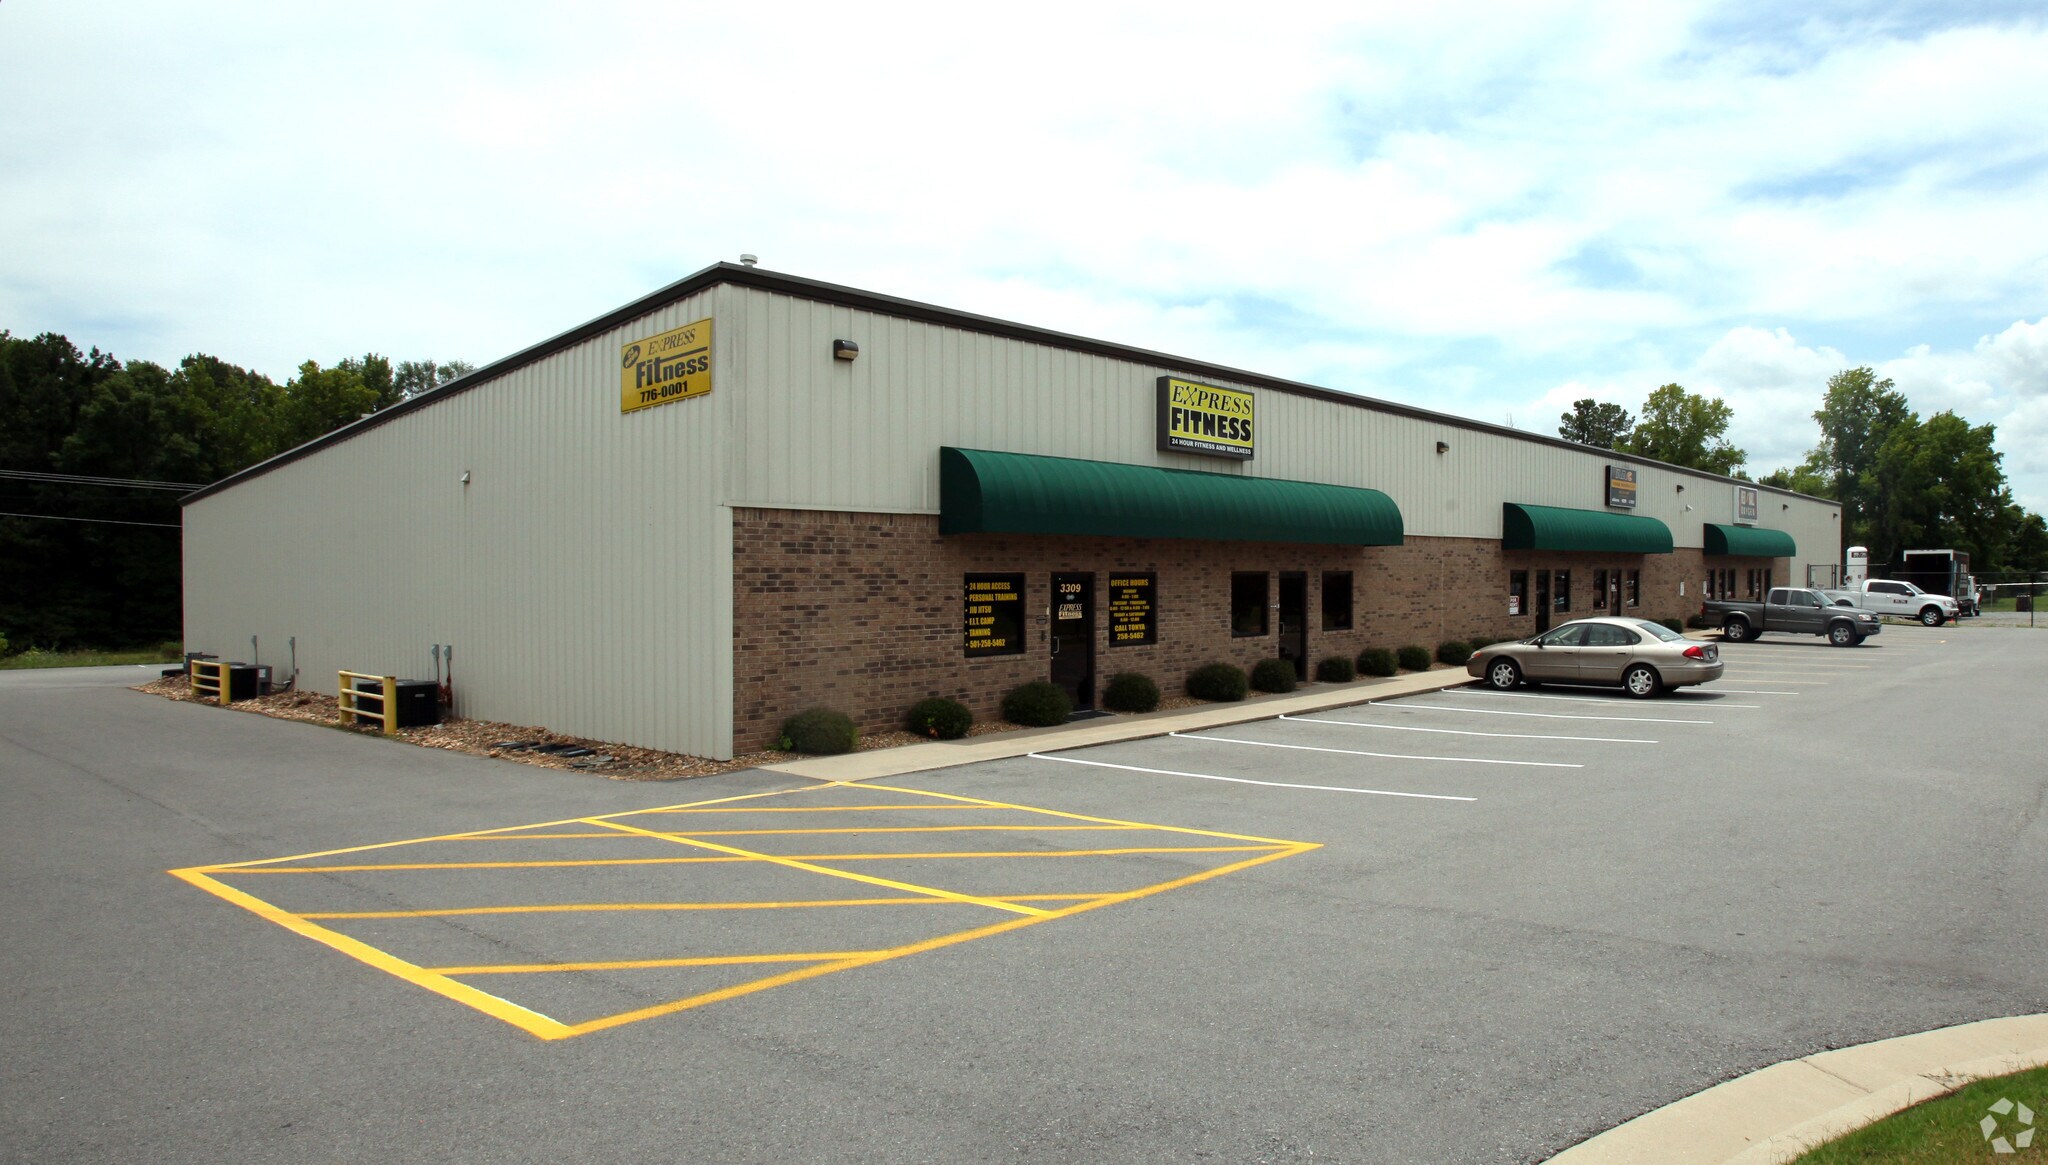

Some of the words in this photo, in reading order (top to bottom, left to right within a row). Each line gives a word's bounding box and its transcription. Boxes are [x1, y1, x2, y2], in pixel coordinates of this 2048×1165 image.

[648, 328, 696, 355] EXPRESS
[636, 355, 709, 389] Fitness
[640, 381, 688, 403] 776-0001
[1172, 385, 1251, 415] EXPRESS
[1171, 406, 1252, 442] FITNESS
[1179, 439, 1194, 447] HOUR
[1194, 441, 1215, 450] FITNESS
[1226, 445, 1252, 455] WELLNESS
[969, 582, 976, 591] 24
[991, 581, 1011, 590] ACCESS
[1060, 583, 1082, 593] 3309
[1110, 579, 1129, 587] OFFICE
[969, 593, 994, 602] PERSONAL
[1059, 603, 1083, 611] EXPRESS
[1114, 624, 1128, 632] CALL
[1128, 623, 1146, 631] TONYA
